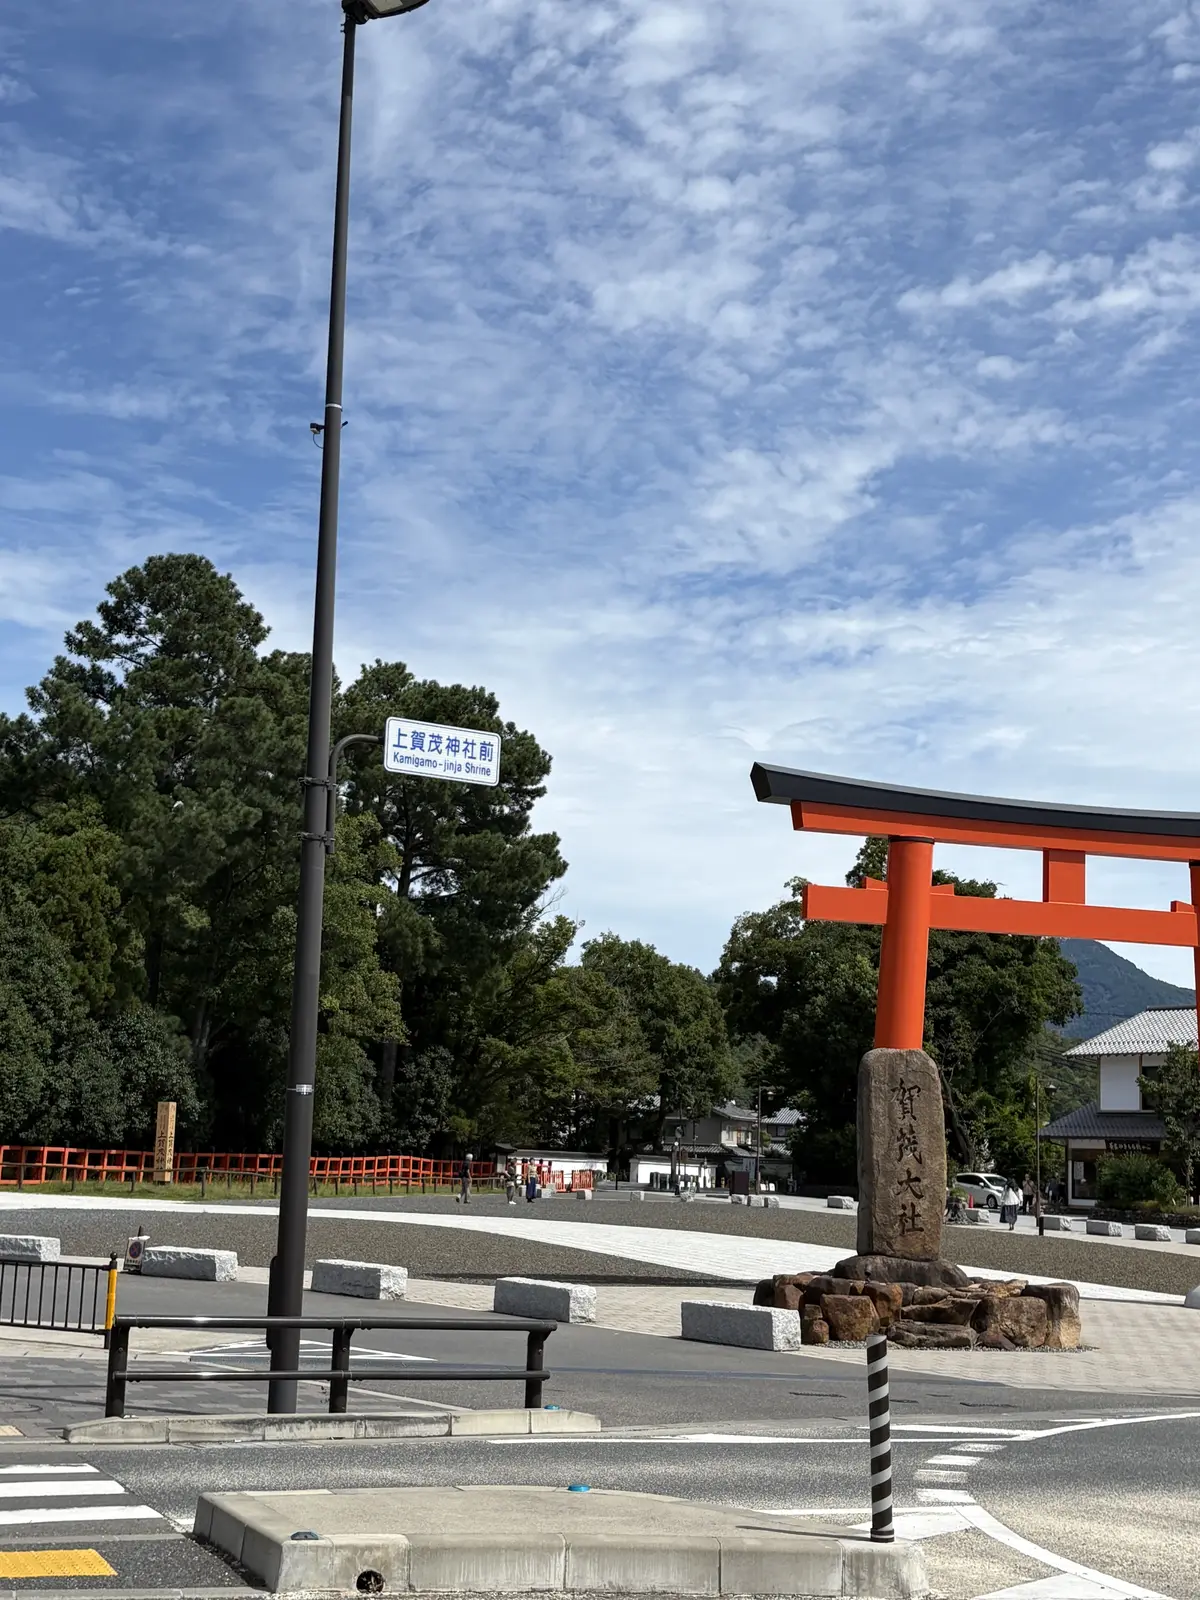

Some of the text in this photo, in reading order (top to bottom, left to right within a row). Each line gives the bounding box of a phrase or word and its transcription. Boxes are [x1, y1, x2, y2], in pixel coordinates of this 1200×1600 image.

[392, 727, 495, 762] 上賀茂神社前
[393, 751, 491, 777] Kamigamo-jinja Shrine
